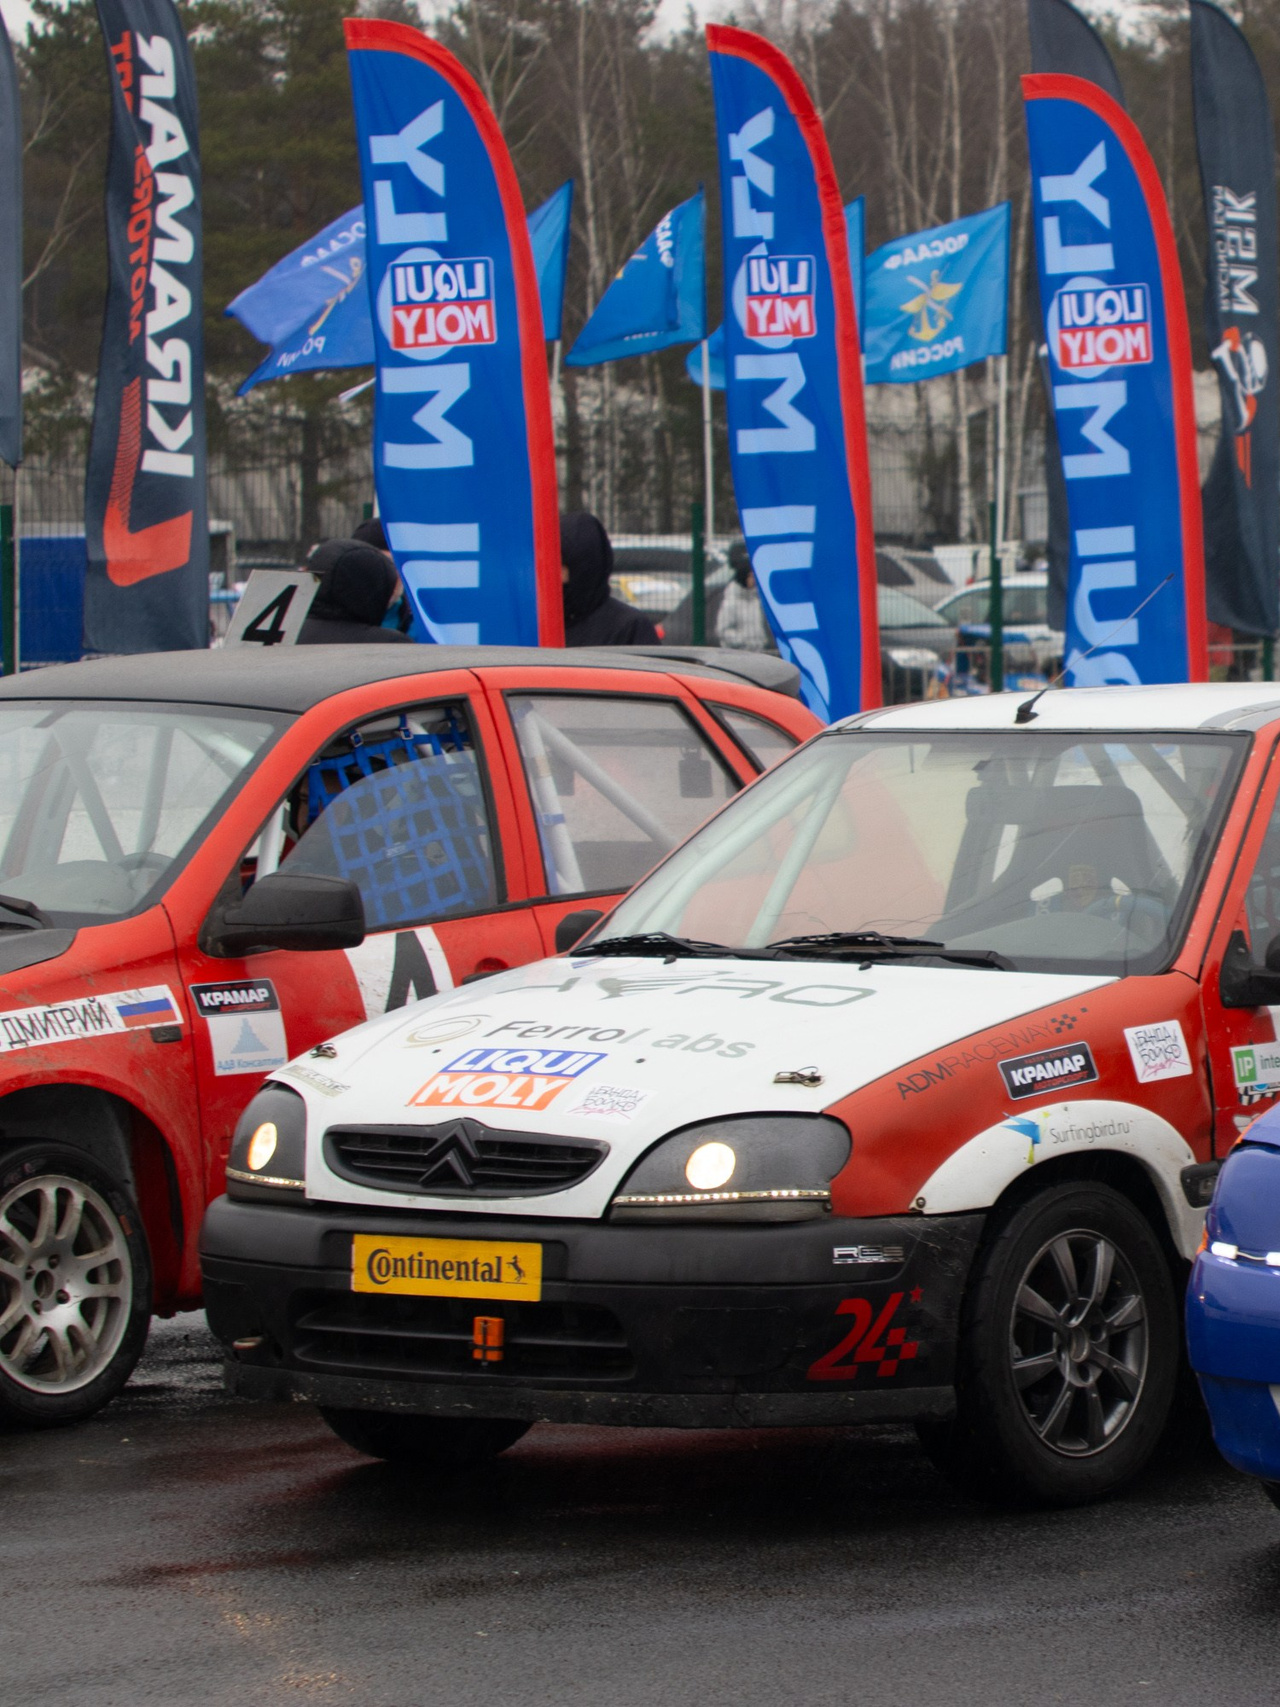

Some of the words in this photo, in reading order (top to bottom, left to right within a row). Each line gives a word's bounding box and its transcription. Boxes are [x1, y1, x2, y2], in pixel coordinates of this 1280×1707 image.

[241, 584, 299, 645] 4
[200, 988, 269, 1006] КРАМАР
[1, 997, 114, 1049] ДМИТРИЙ
[450, 1050, 602, 1075] LIQUI
[1010, 1054, 1086, 1086] КРАМАР
[1238, 1056, 1254, 1078] IP
[414, 1075, 571, 1107] MOLY
[1049, 1119, 1131, 1145] Surfingbird.ru
[366, 1247, 503, 1286] Continental
[806, 1299, 921, 1381] 24
